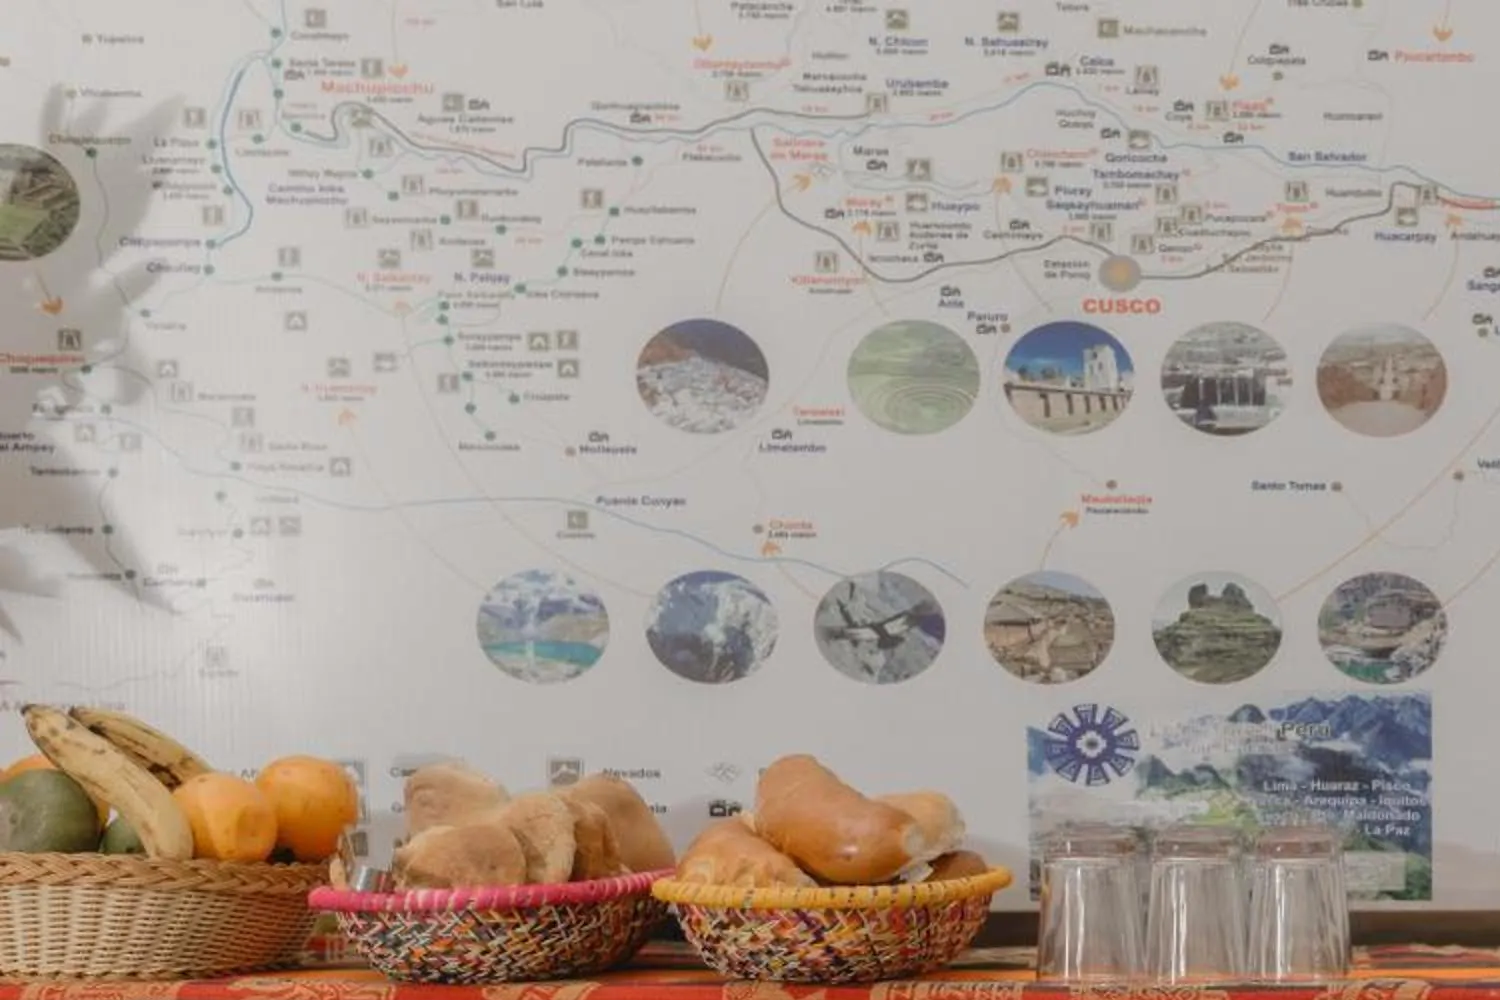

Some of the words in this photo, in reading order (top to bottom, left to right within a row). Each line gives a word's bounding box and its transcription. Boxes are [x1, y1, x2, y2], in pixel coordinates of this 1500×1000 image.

[1083, 298, 1161, 314] CUSCO
[1252, 481, 1286, 491] Santo
[1290, 481, 1325, 491] Tomas
[1264, 780, 1297, 791] Lima
[1311, 780, 1359, 792] Huaraz
[1365, 825, 1381, 836] La
[1384, 825, 1410, 836] Paz
